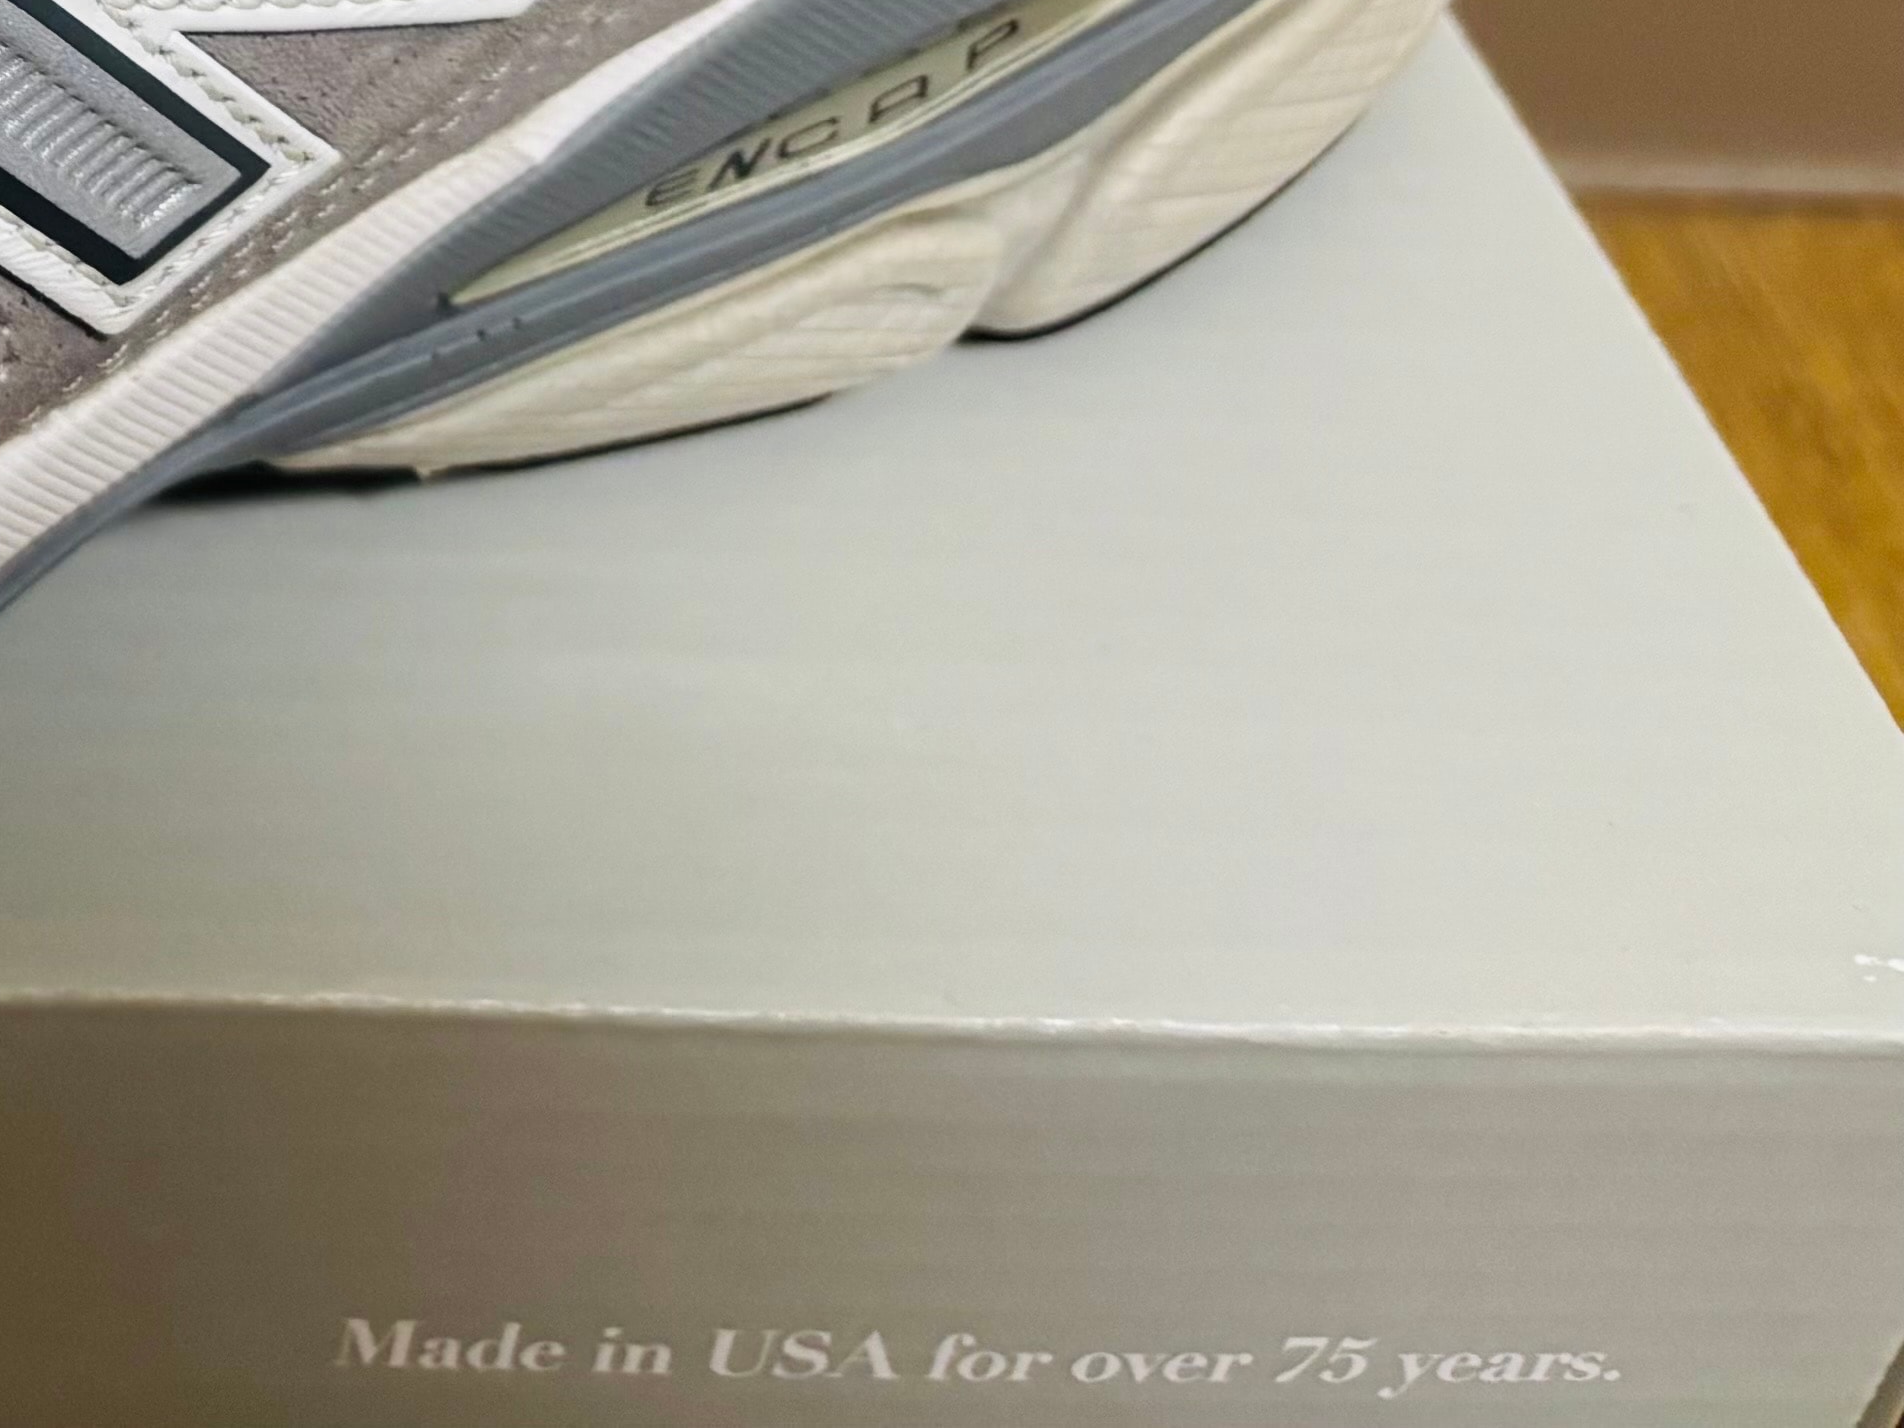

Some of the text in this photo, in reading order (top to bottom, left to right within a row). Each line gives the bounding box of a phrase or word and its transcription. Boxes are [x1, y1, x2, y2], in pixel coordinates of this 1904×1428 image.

[645, 18, 1020, 207] ENCAP
[333, 1318, 1622, 1400] Made in USA for over 75 years.
